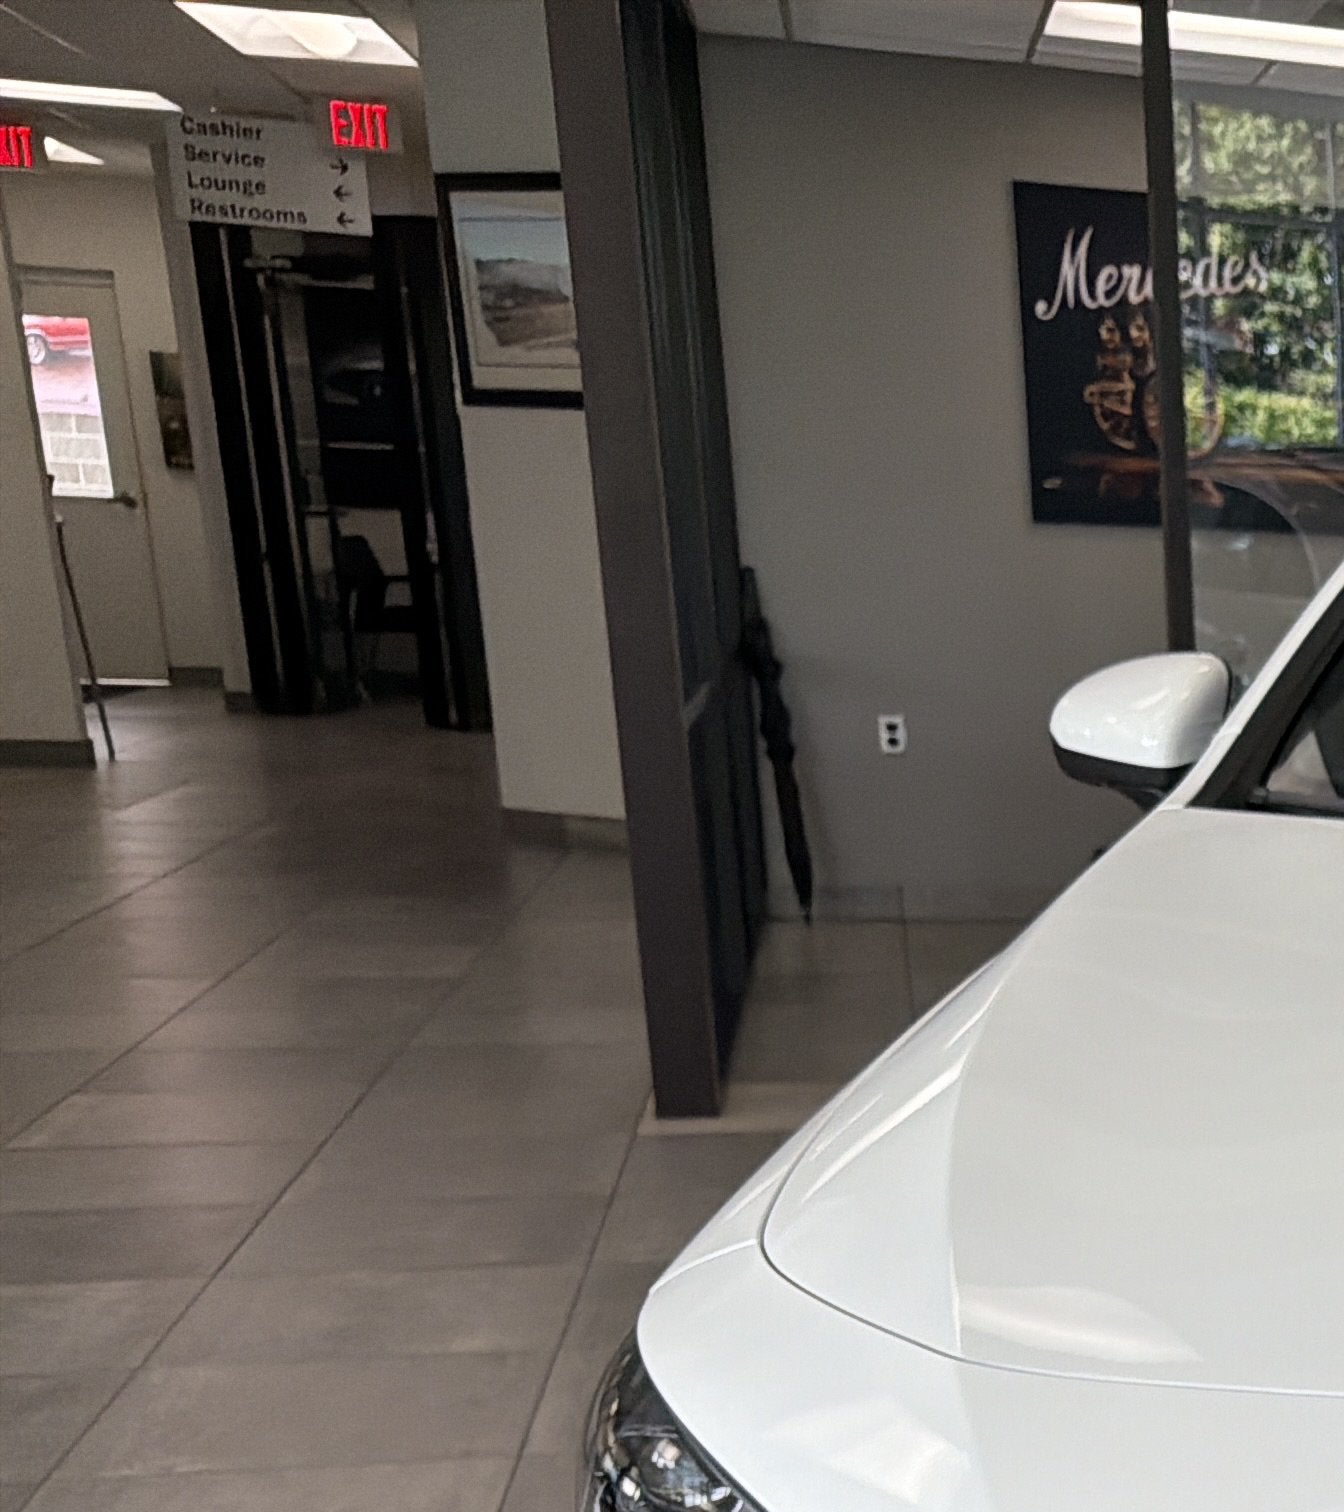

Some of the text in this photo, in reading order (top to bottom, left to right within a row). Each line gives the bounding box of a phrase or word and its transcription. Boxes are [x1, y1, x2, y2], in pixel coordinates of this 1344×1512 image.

[180, 115, 263, 140] Cashier
[329, 100, 389, 150] EXIT
[0, 125, 33, 169] XIT
[183, 142, 266, 168] Service
[187, 170, 267, 197] Lounge
[190, 197, 308, 225] Restrooms
[1034, 225, 1269, 321] Meredes
